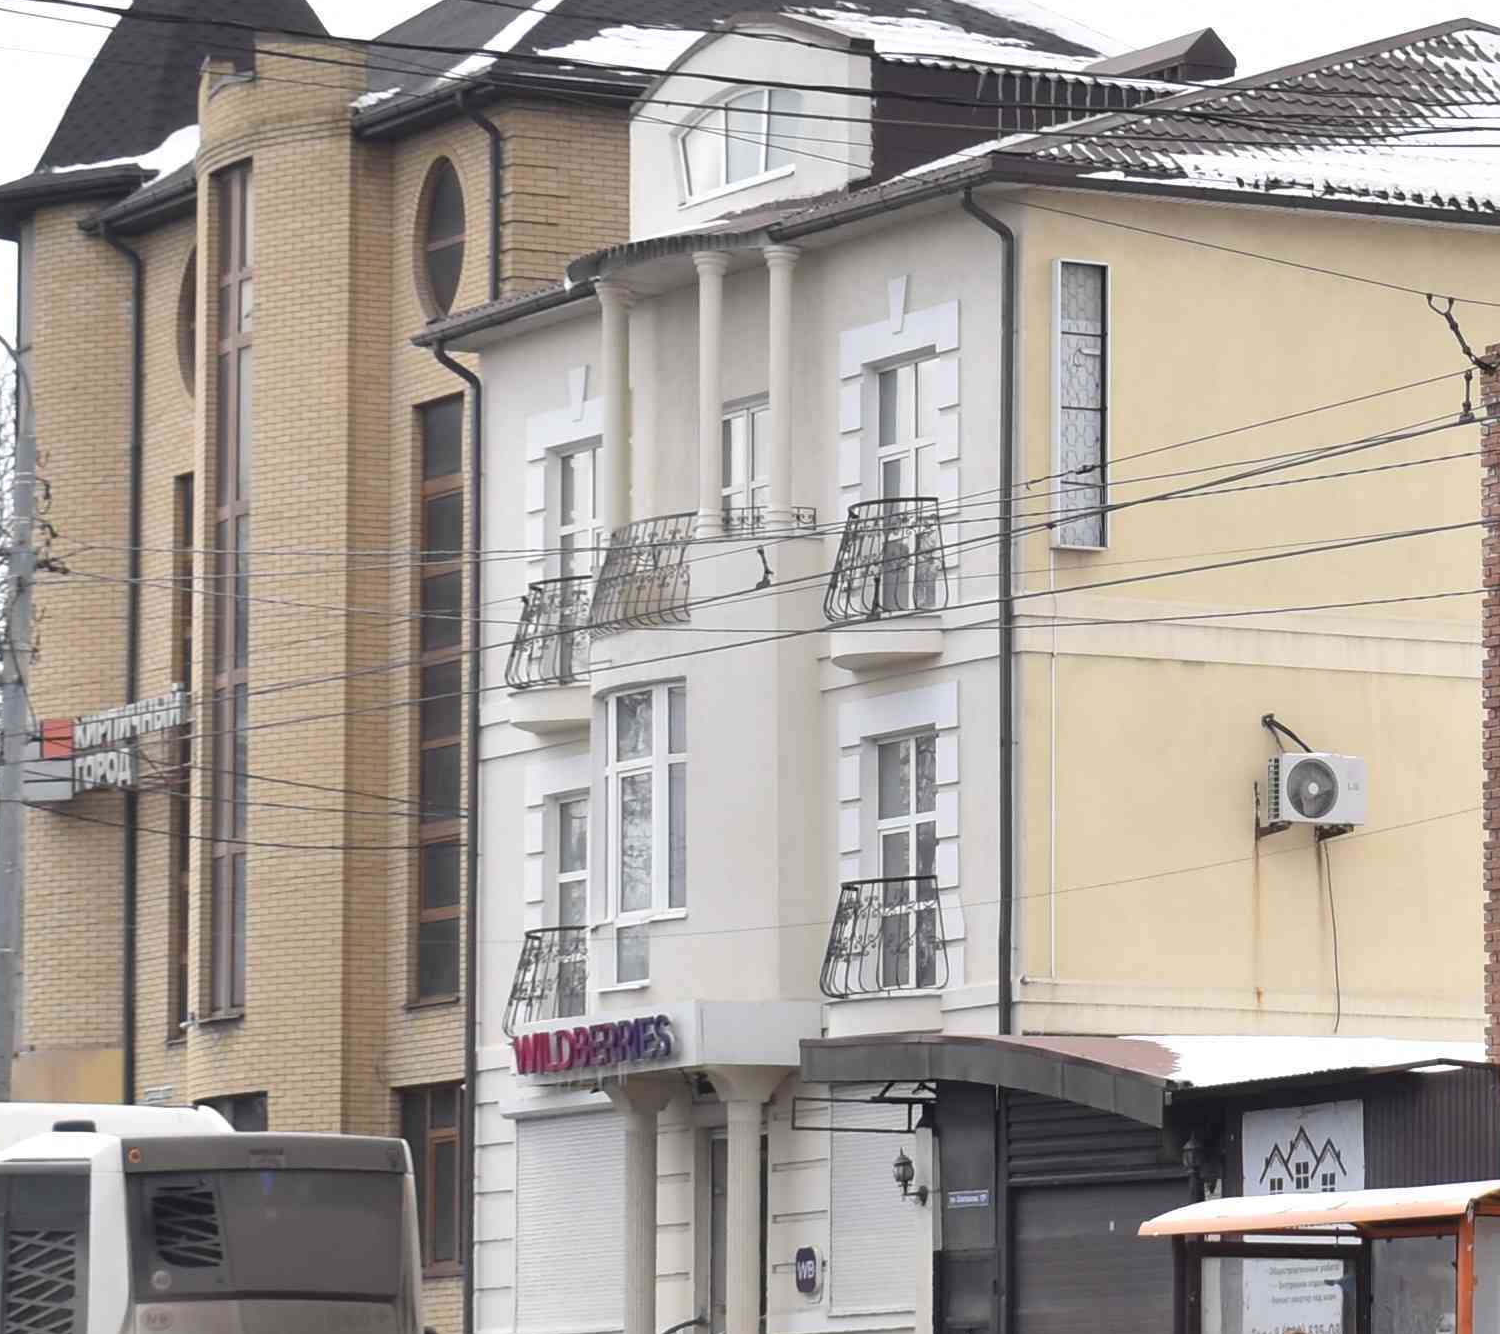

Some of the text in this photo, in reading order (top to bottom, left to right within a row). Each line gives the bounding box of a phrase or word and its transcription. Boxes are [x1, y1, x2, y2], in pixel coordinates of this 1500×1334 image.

[74, 748, 134, 793] ГОРОД
[514, 1013, 673, 1075] WILDBERRIES
[797, 1260, 815, 1280] WB
